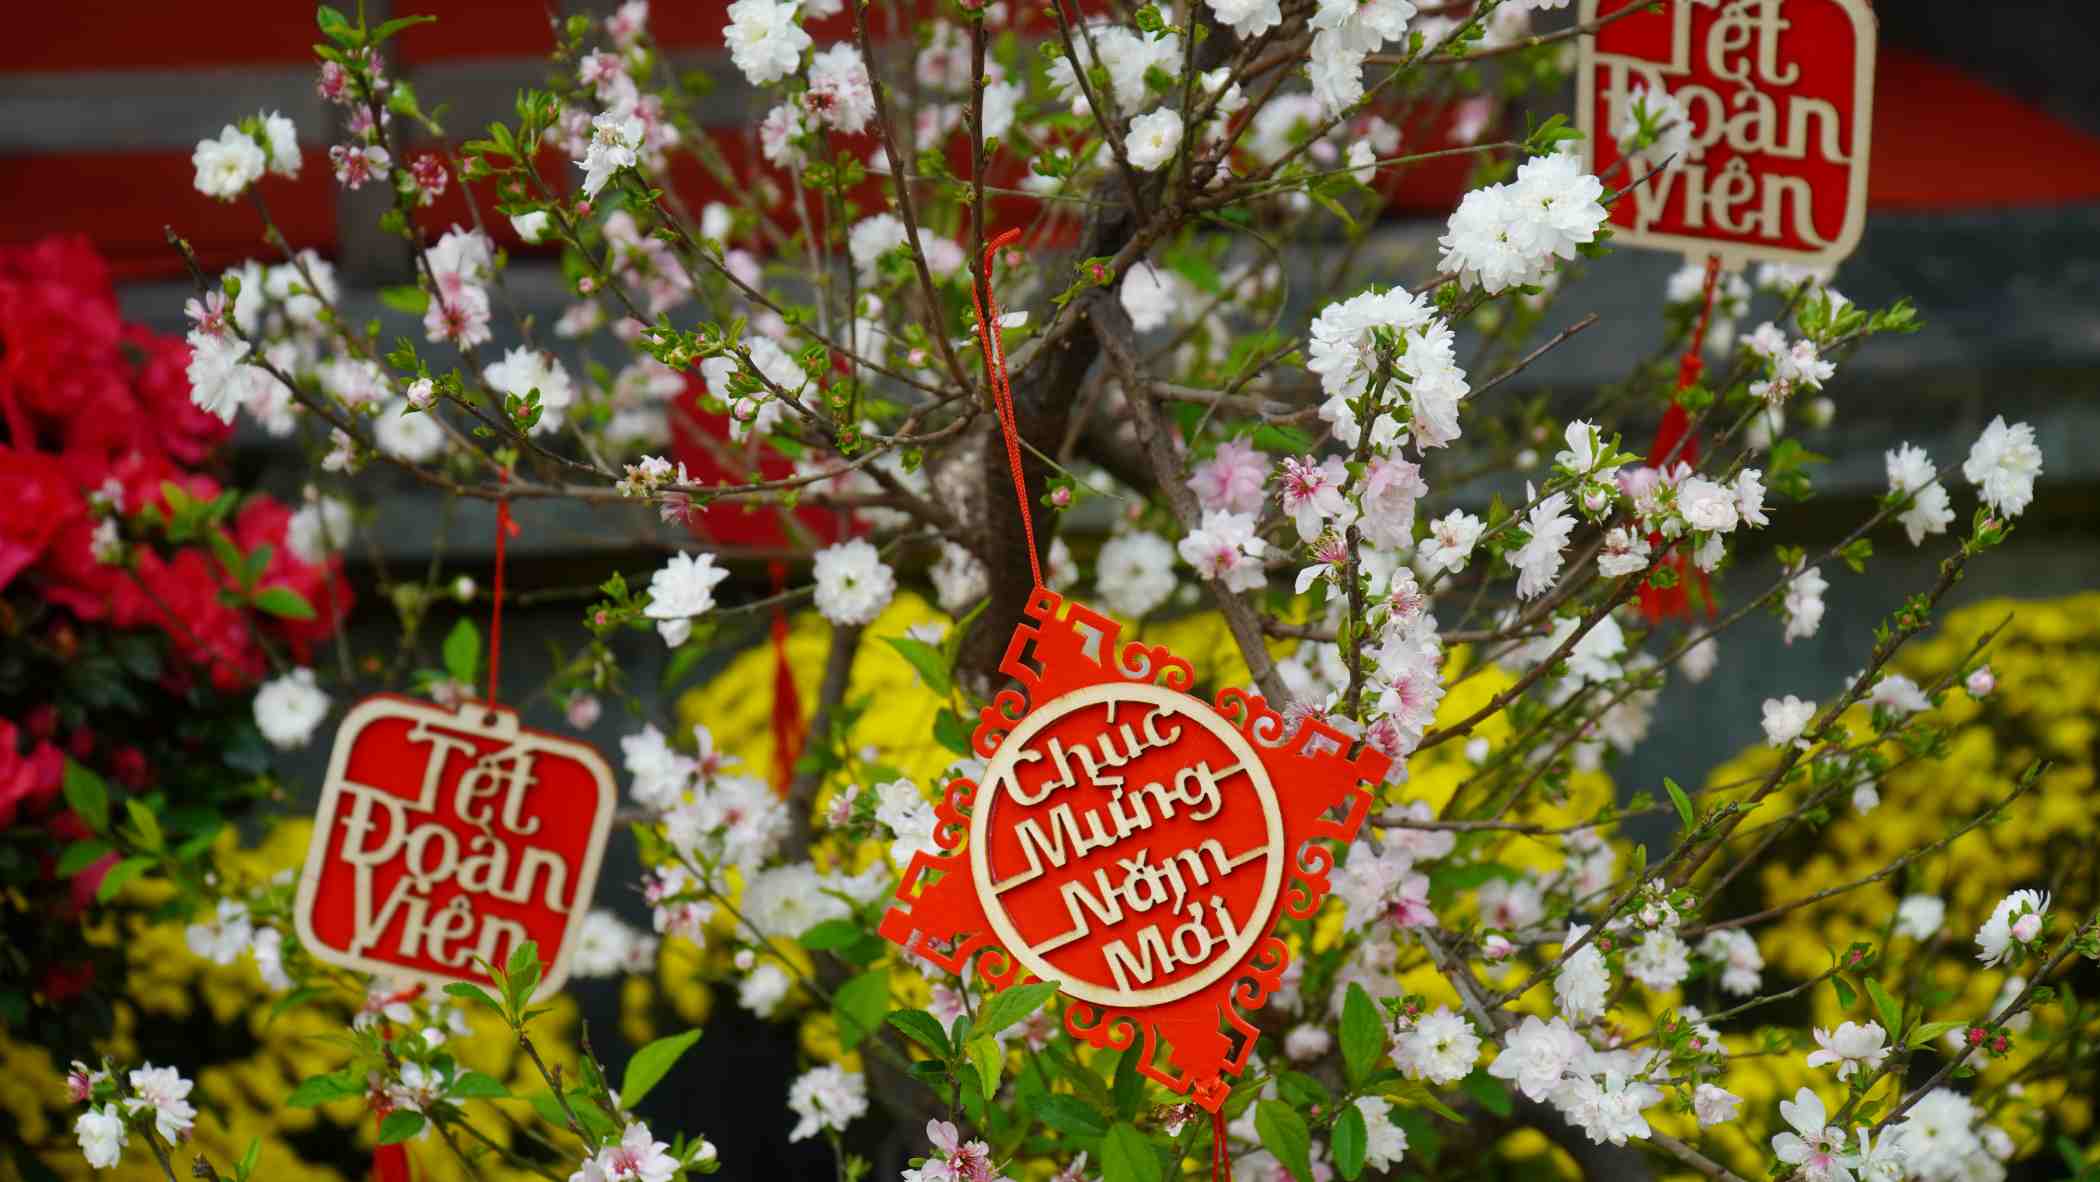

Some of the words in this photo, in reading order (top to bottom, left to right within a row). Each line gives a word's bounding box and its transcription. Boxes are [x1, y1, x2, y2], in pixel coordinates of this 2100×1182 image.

[1629, 154, 1830, 246] Viên
[407, 728, 540, 834] Tết
[1004, 700, 1181, 806] Chúc
[341, 788, 568, 913] Đoàn
[1014, 761, 1222, 876] Mừng
[355, 866, 532, 973] Viên
[1060, 839, 1233, 936] Năm
[1102, 894, 1239, 991] Mới
